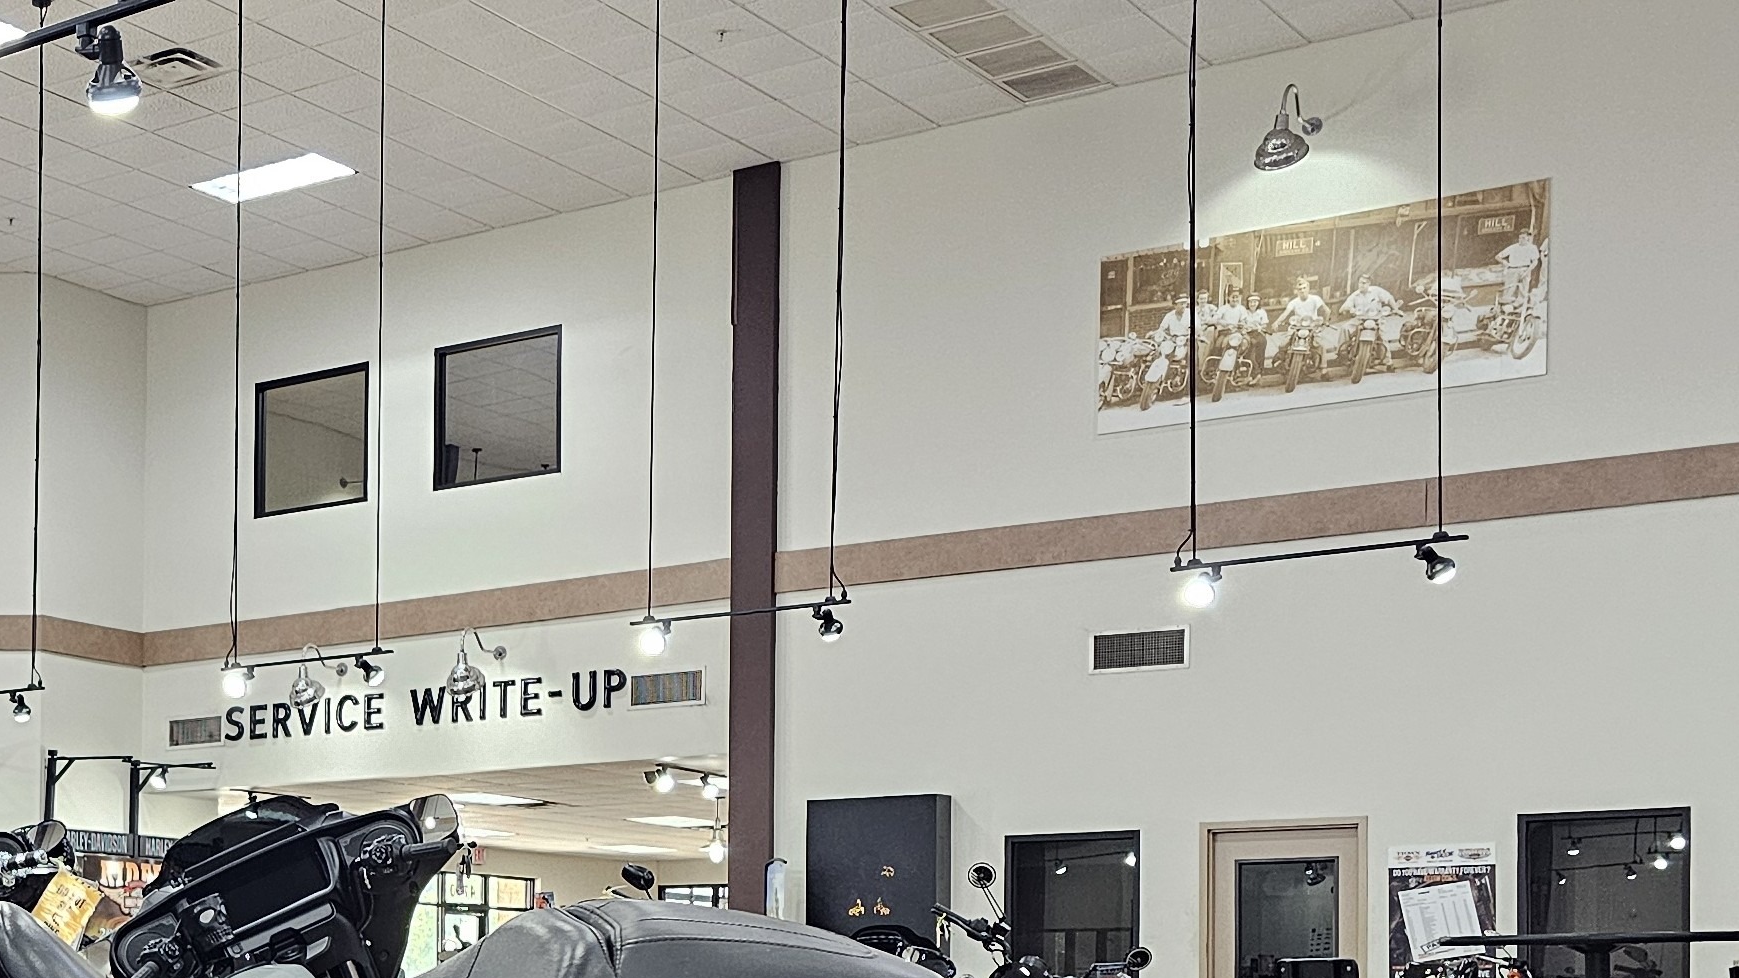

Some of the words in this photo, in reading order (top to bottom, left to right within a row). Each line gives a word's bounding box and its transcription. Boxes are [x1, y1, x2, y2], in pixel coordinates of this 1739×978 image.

[224, 692, 385, 742] SERVICE
[409, 669, 627, 726] WRITE-UP
[65, 831, 128, 854] ARLEY-DAVIDSON
